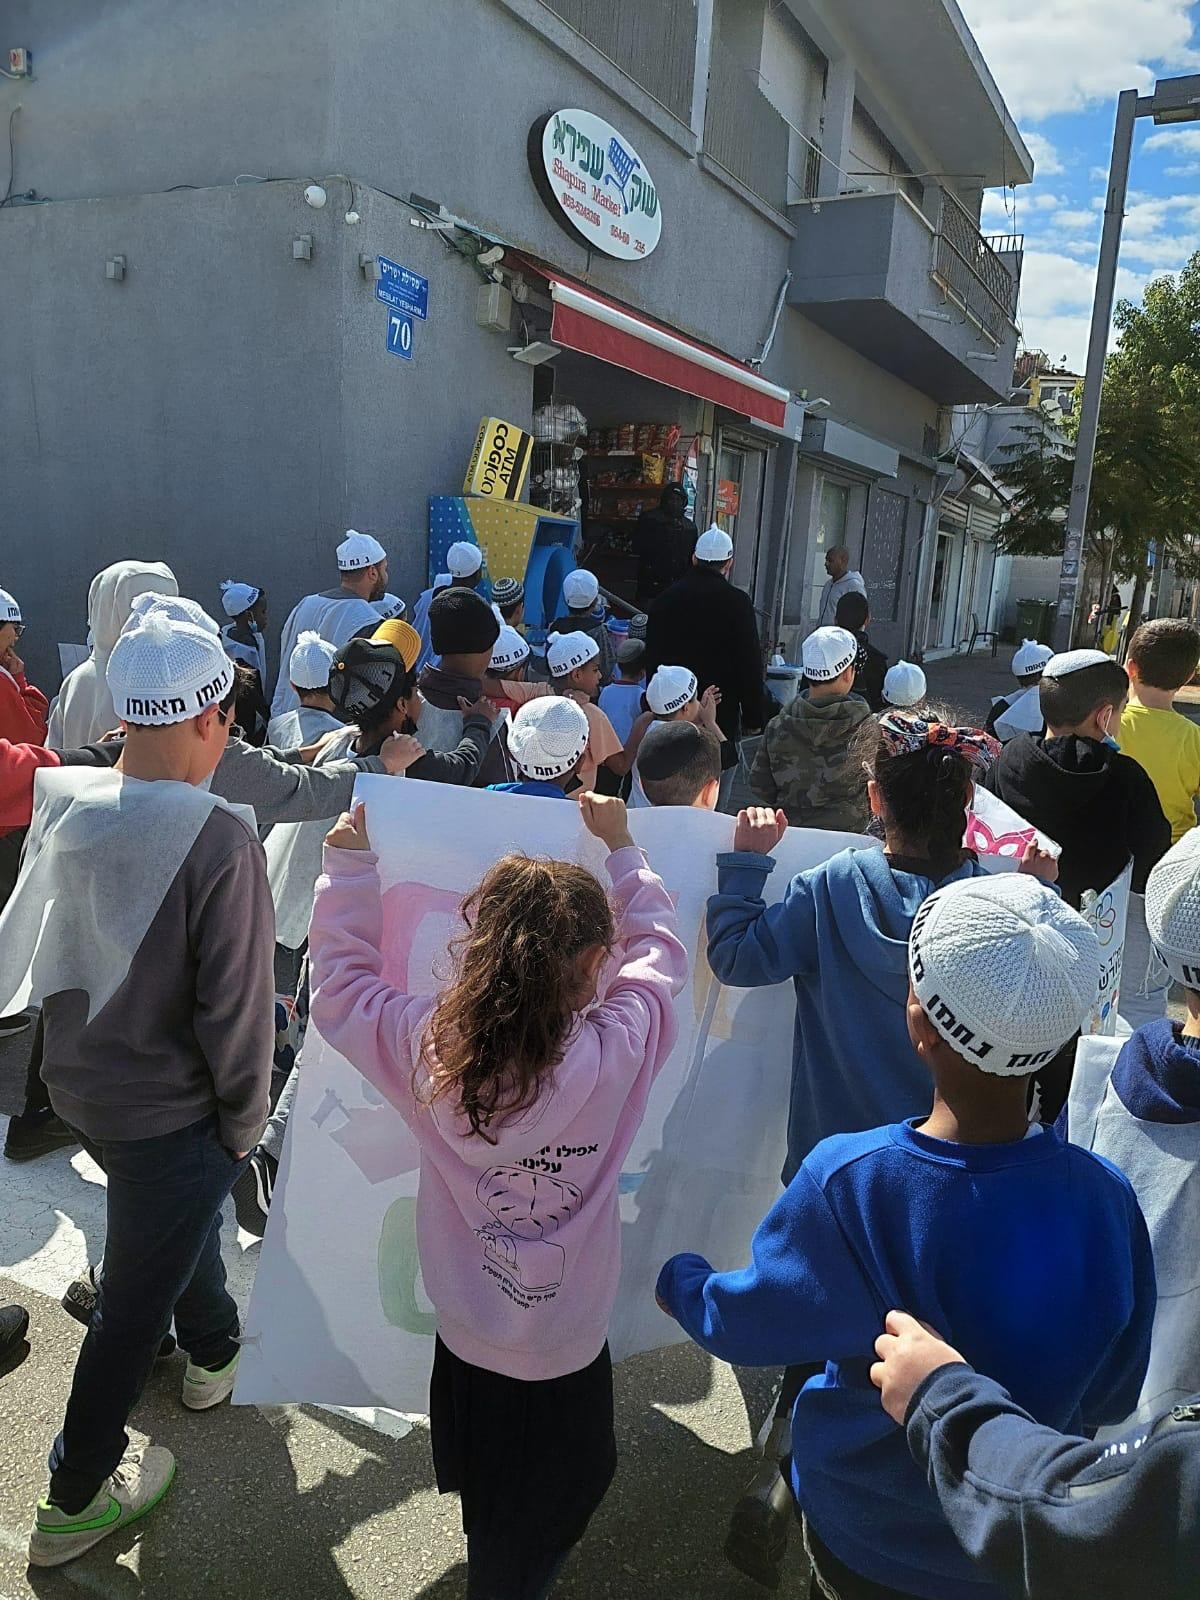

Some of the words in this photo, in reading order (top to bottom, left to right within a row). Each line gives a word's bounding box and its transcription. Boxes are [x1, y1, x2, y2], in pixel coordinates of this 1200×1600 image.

[552, 114, 605, 181] שפירא
[552, 157, 587, 195] Shapira
[591, 184, 622, 218] Market
[630, 173, 658, 218] שוק
[378, 288, 399, 305] MESILAT
[391, 316, 411, 351] 70
[498, 447, 517, 485] ATM
[570, 654, 582, 666] נח
[834, 652, 853, 673] נחמן
[195, 670, 228, 708] נחמן
[664, 692, 689, 711] מאומן
[126, 697, 187, 716] מאומן
[534, 765, 562, 777] נחמ
[926, 994, 994, 1059] נחמן
[556, 1143, 599, 1158] אפילו
